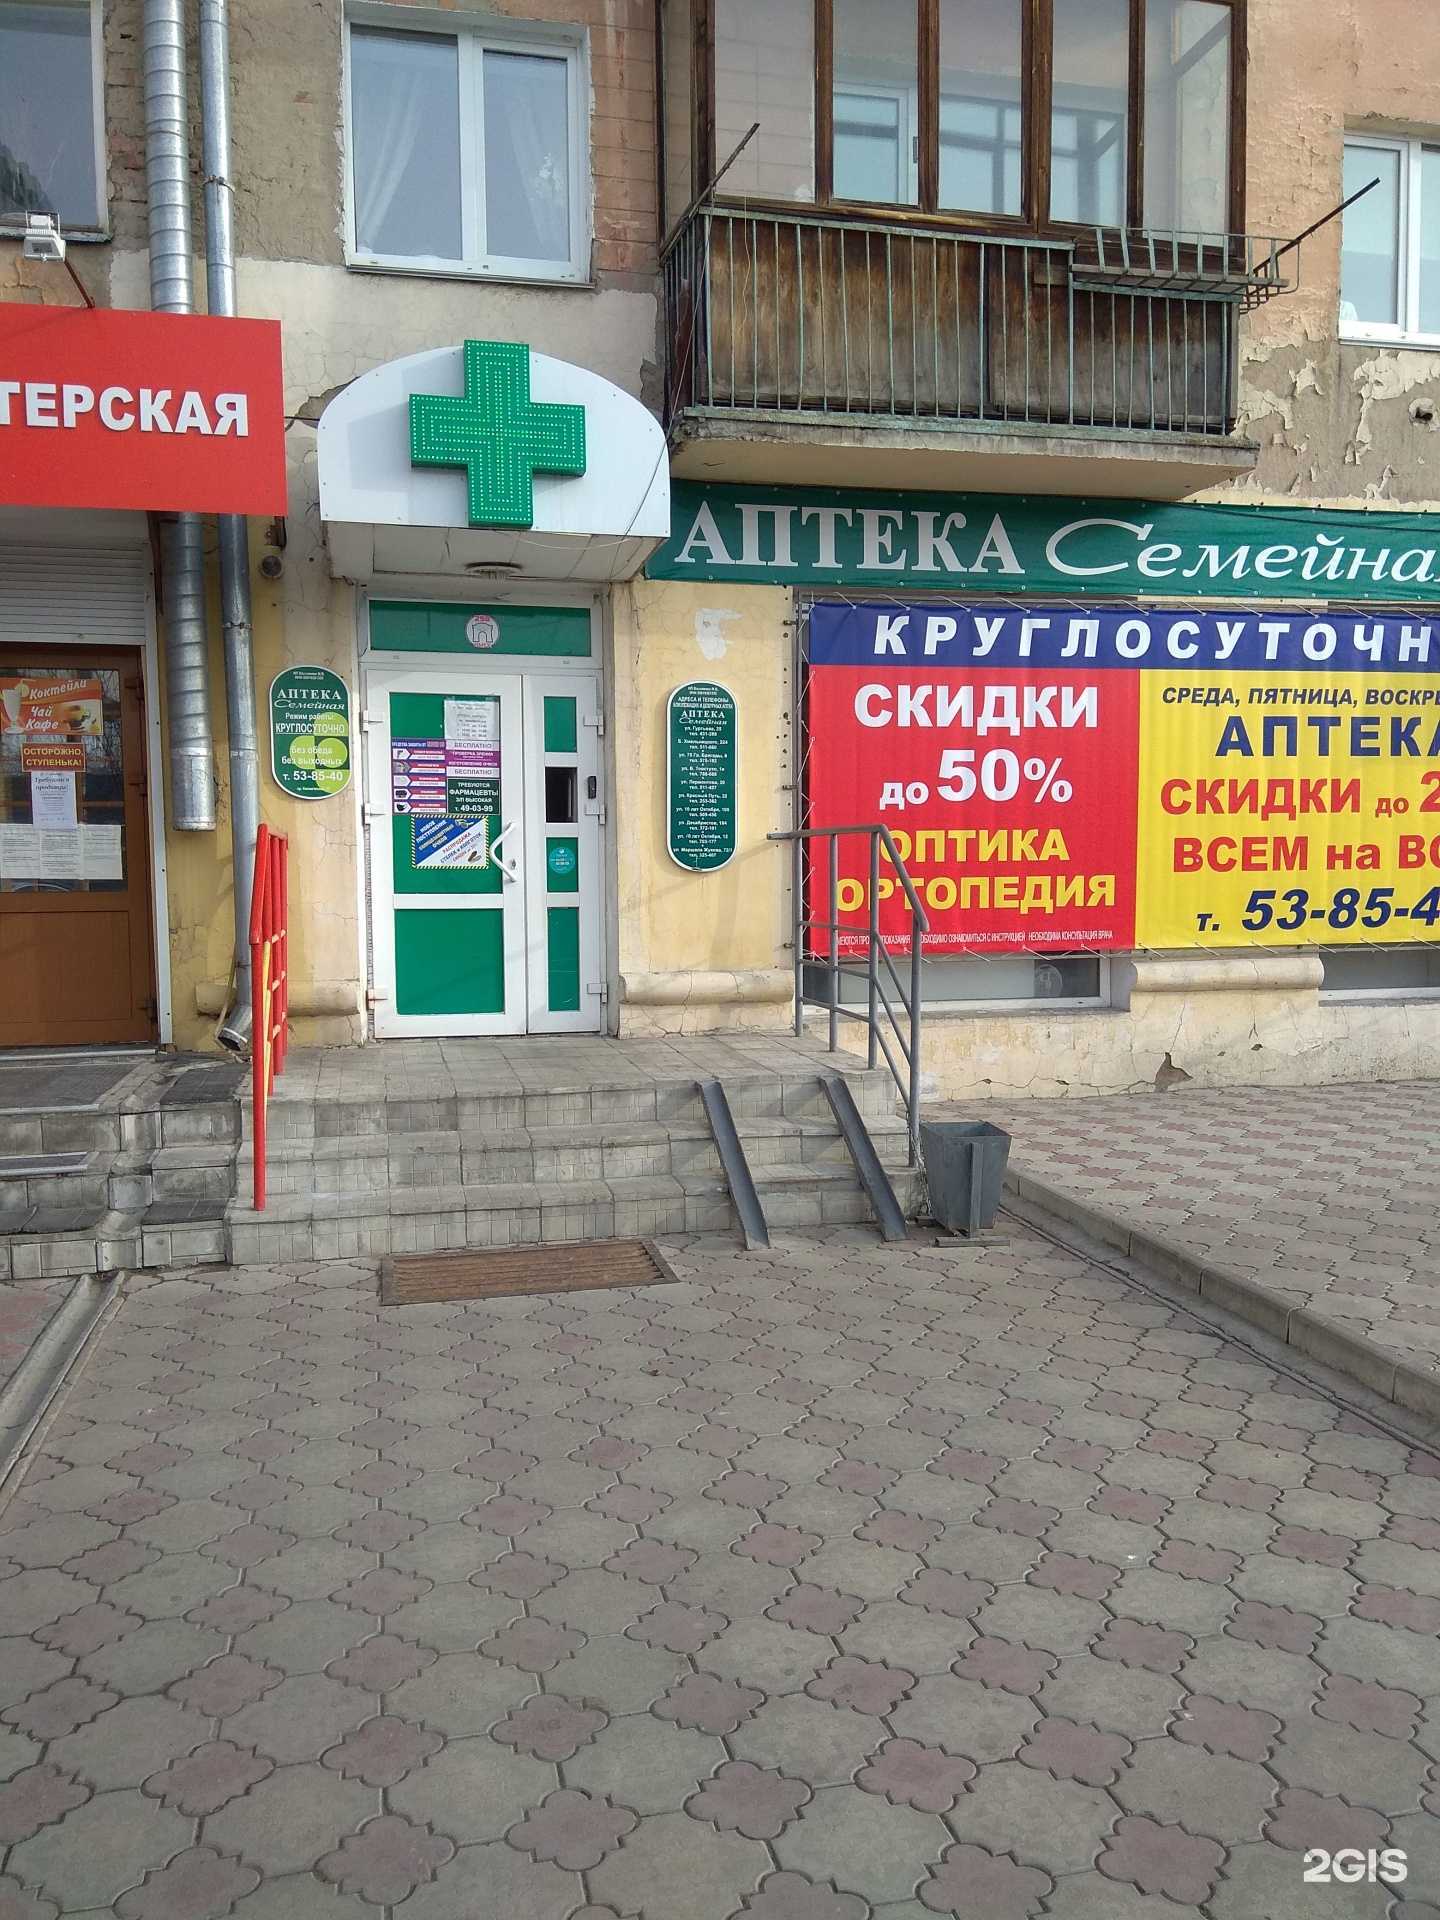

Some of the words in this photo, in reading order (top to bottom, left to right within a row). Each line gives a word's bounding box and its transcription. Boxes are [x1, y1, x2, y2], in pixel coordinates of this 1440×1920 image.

[0, 381, 249, 437] ТЕРСКАЯ
[674, 500, 1026, 574] АПТЕКА
[1046, 518, 1440, 582] Семейна
[874, 614, 1432, 663] КРУГЛОСУТОЧН
[29, 679, 88, 700] Коктейли
[277, 688, 342, 700] АПТЕКА
[1162, 687, 1240, 707] СРЕДА,
[1247, 688, 1358, 708] ПЯТНИЦА,
[31, 704, 54, 717] Чай
[273, 699, 345, 710] Семейная
[681, 709, 726, 718] АПТЕКА
[854, 683, 1098, 737] СКИДКИ
[285, 712, 308, 720] Режим
[275, 722, 345, 733] КРУГЛОСУТОЧНО
[26, 758, 82, 767] СТУПЕНЬКА!
[281, 755, 297, 765] без
[283, 772, 290, 780] т.
[293, 770, 343, 781] 53-85-40
[879, 781, 929, 811] до
[936, 748, 1074, 804] 50%
[460, 804, 493, 812] 49-03-99
[1160, 778, 1361, 821] СКИДКИ
[1374, 797, 1410, 818] до
[879, 828, 1071, 863] ОПТИКА
[1173, 835, 1309, 873] ВСЕМ
[1326, 842, 1381, 871] на
[835, 874, 1116, 915] ОРТОПЕДИЯ
[1196, 913, 1221, 932] т.
[837, 936, 858, 946] ЕЮТСЯ
[920, 933, 948, 944] ОБХОДИМО
